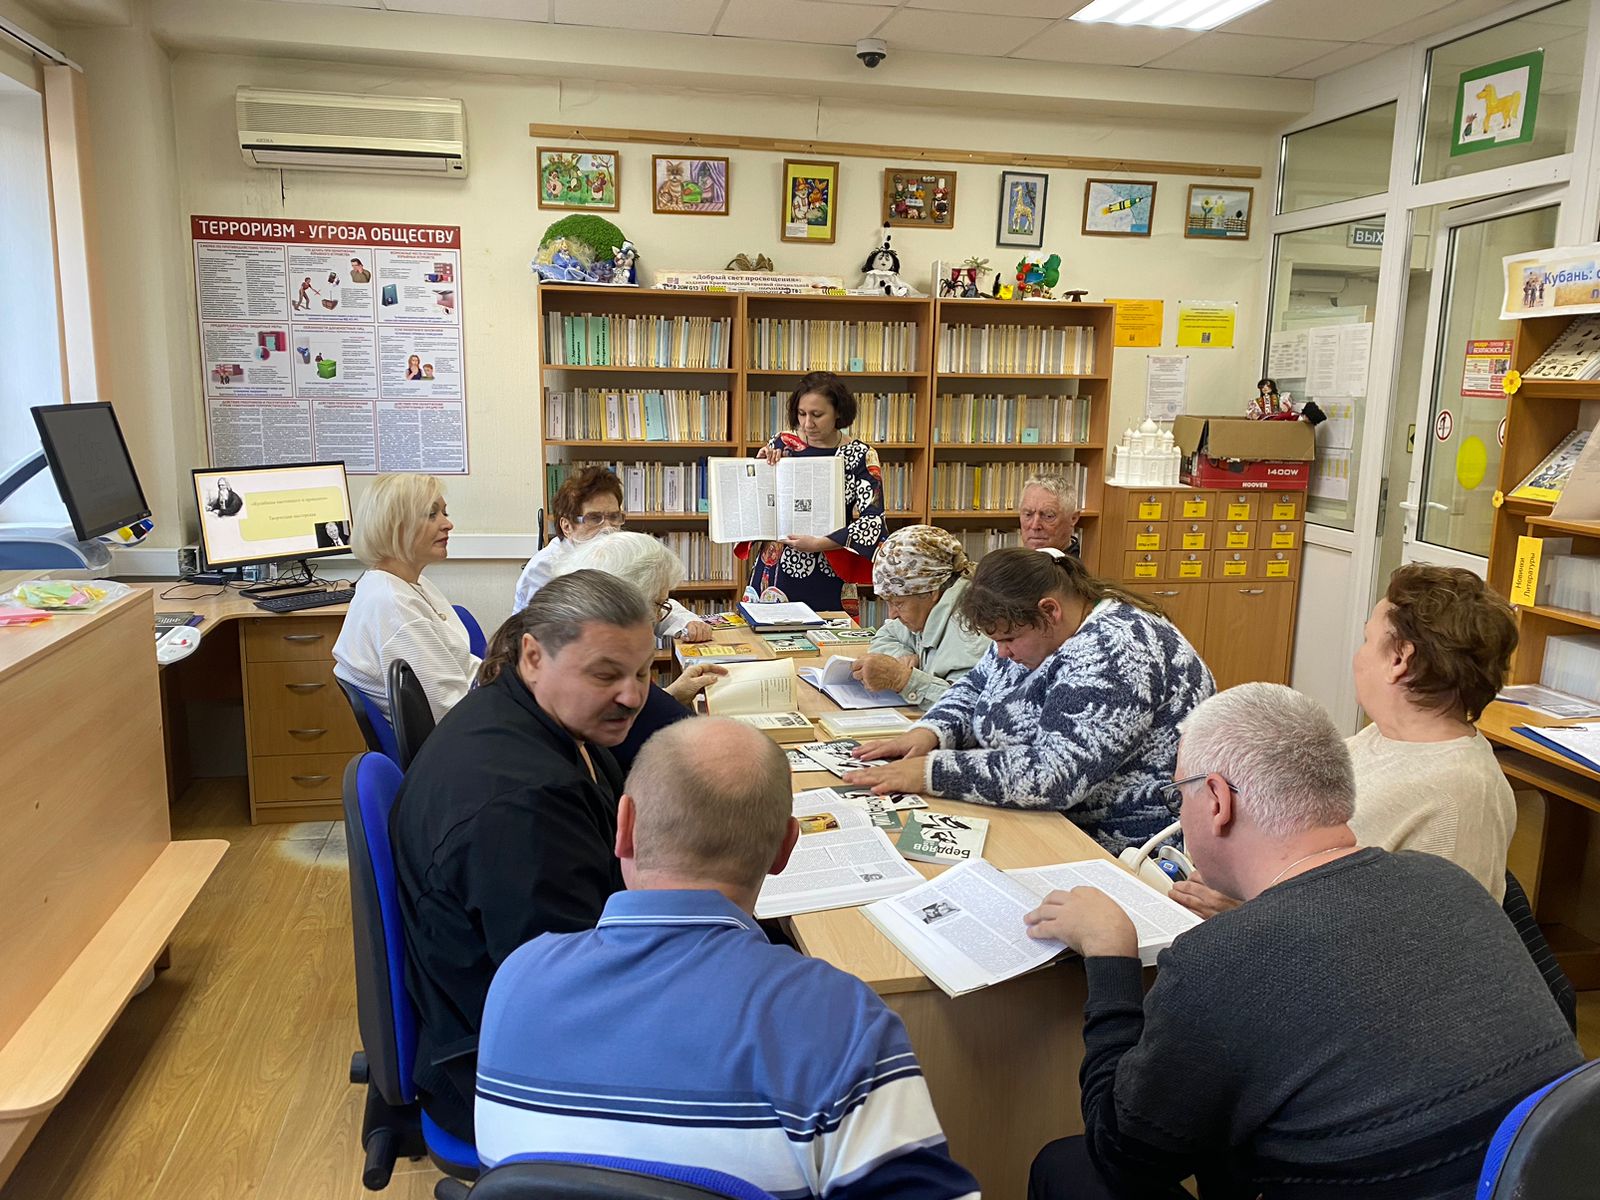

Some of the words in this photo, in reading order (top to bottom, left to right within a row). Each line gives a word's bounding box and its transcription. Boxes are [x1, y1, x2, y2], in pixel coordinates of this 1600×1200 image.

[199, 220, 295, 238] ТЕРРОРИЗМ
[309, 225, 367, 240] УГРОЗА
[371, 227, 454, 244] ОБЩЕСТВУ
[1544, 270, 1592, 287] Кубань:
[1267, 468, 1299, 476] 1400W
[1515, 557, 1525, 589] Новинки
[1523, 552, 1536, 597] Литературы
[912, 842, 971, 859] Бердяев
